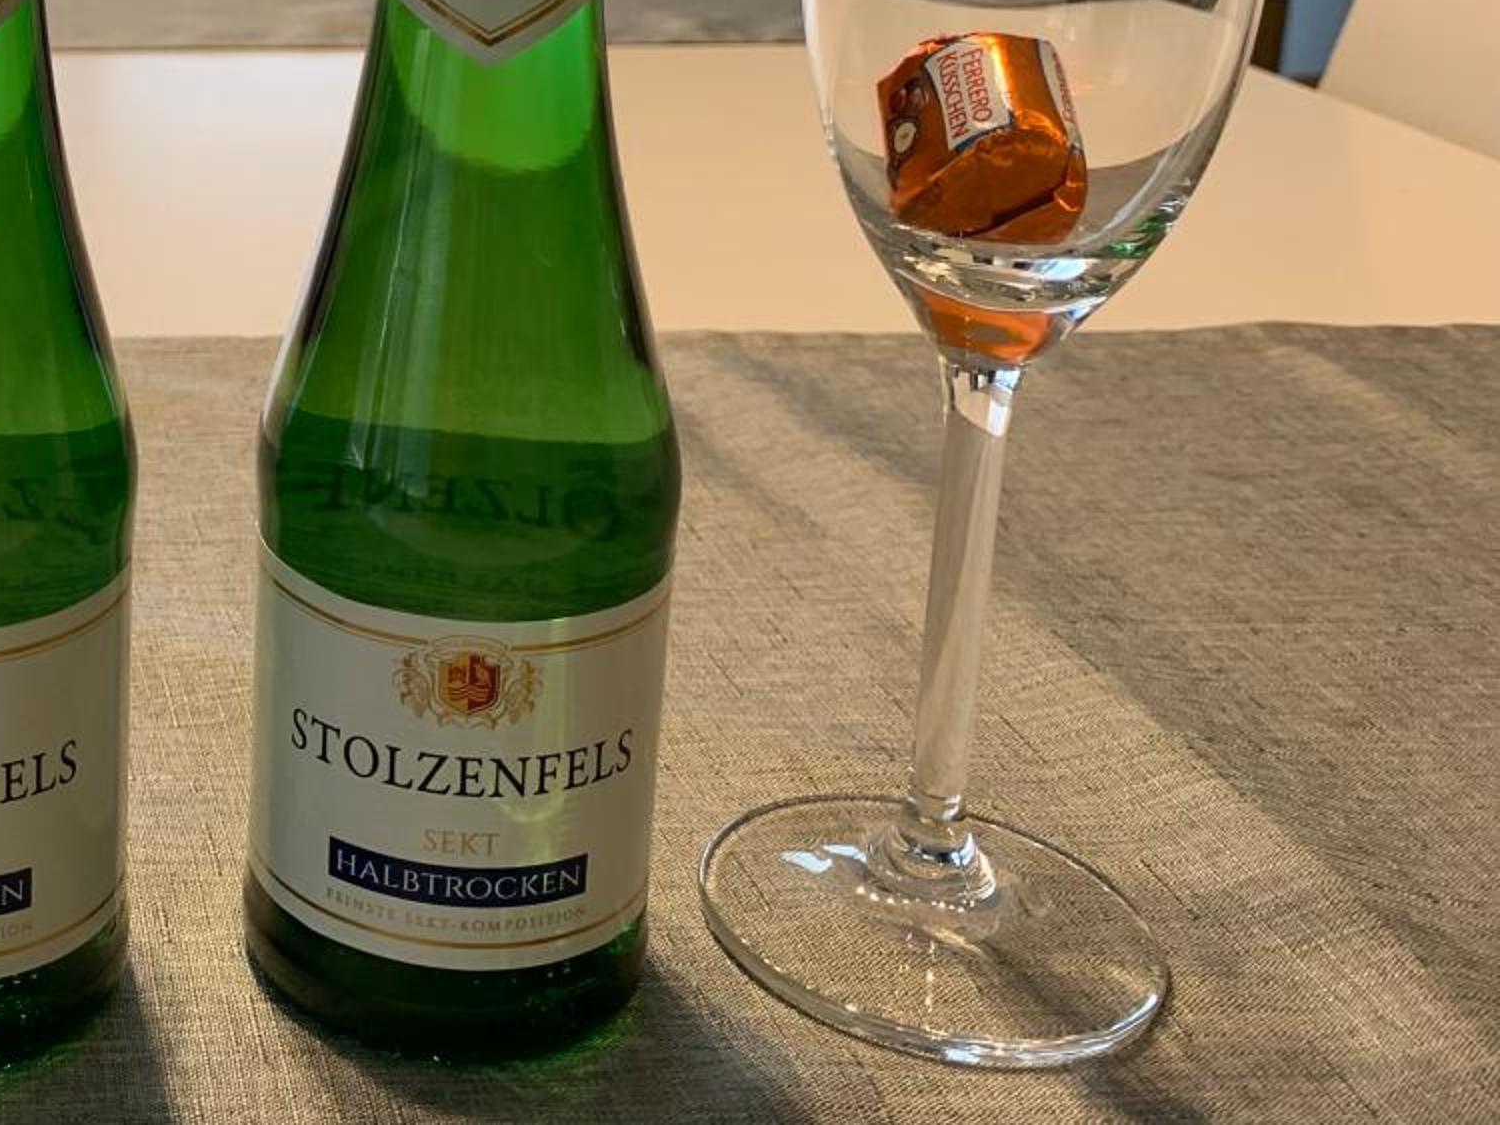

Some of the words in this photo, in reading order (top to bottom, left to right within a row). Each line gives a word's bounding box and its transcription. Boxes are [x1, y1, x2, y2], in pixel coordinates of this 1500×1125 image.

[959, 47, 993, 122] FERRERO
[290, 708, 634, 798] STOLZENFELS
[336, 847, 581, 901] HALBTROCKEN
[422, 827, 501, 857] SEKT
